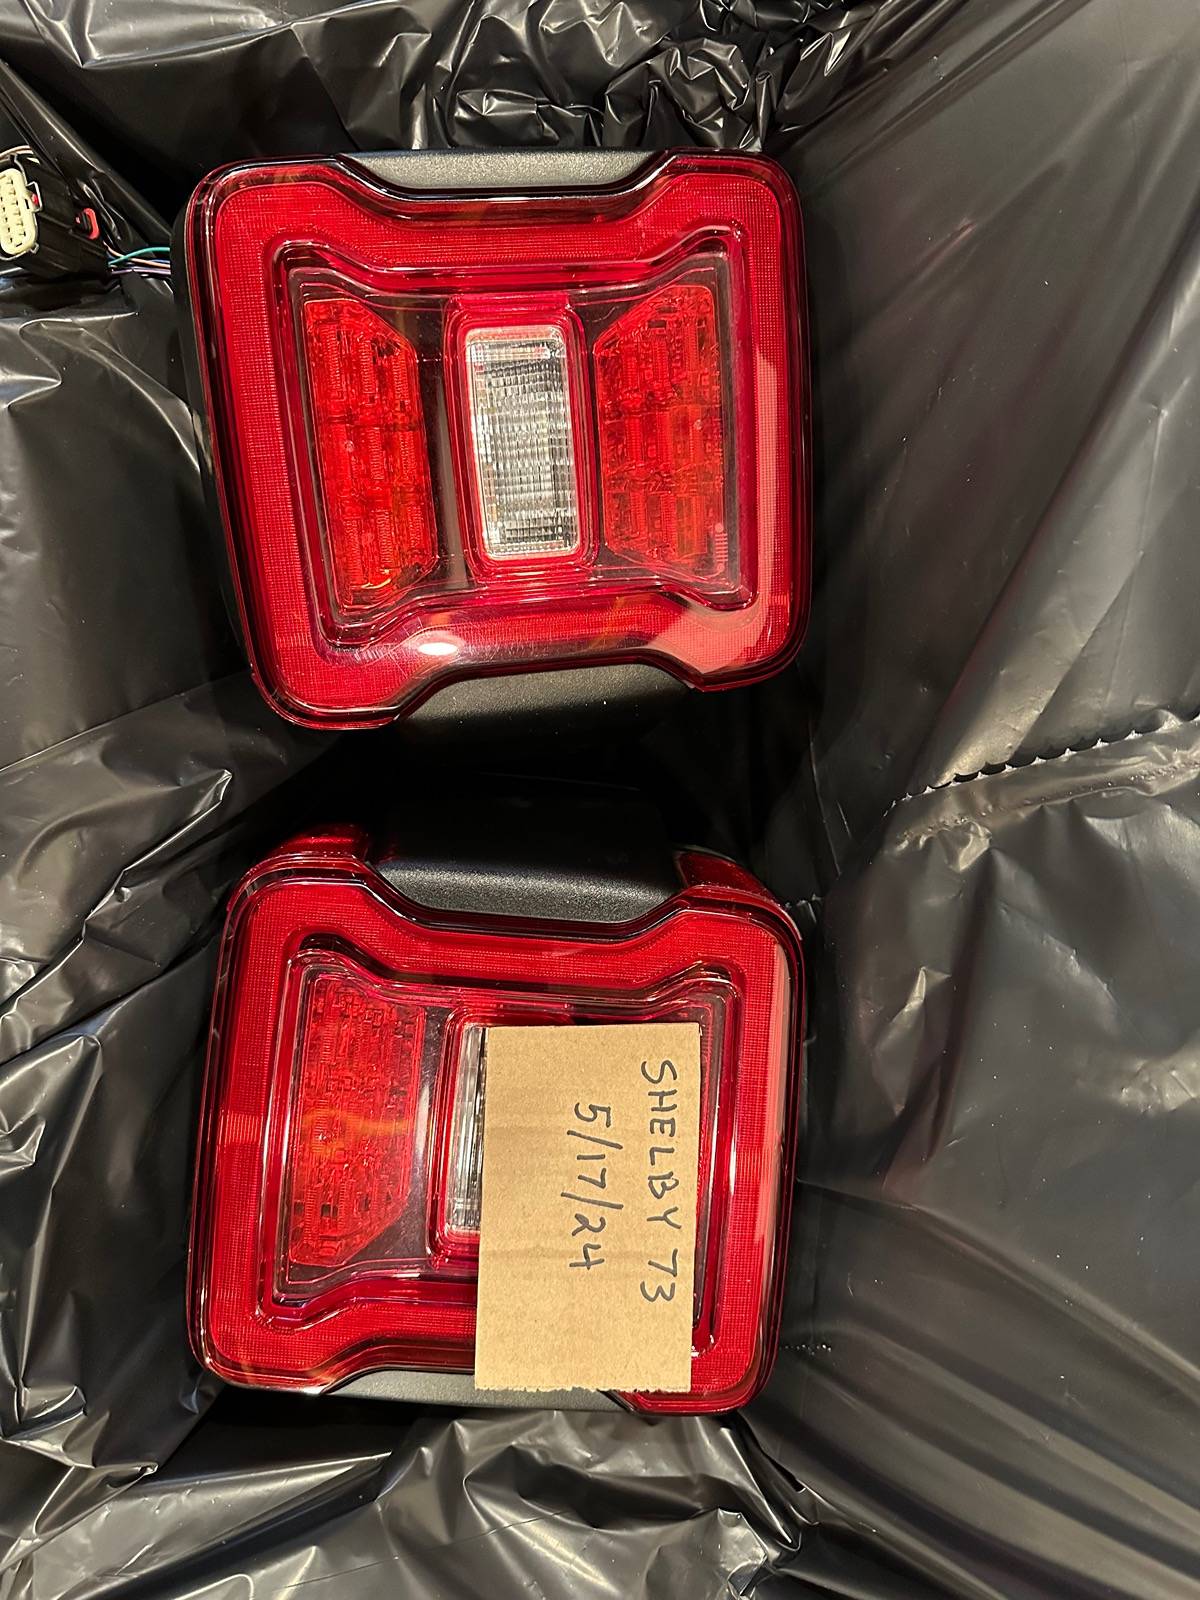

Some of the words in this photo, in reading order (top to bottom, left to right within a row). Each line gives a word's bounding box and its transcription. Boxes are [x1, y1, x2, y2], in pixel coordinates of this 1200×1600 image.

[560, 1102, 624, 1271] 5/17/24
[640, 1059, 682, 1230] SHELBY
[639, 1248, 679, 1302] 73
